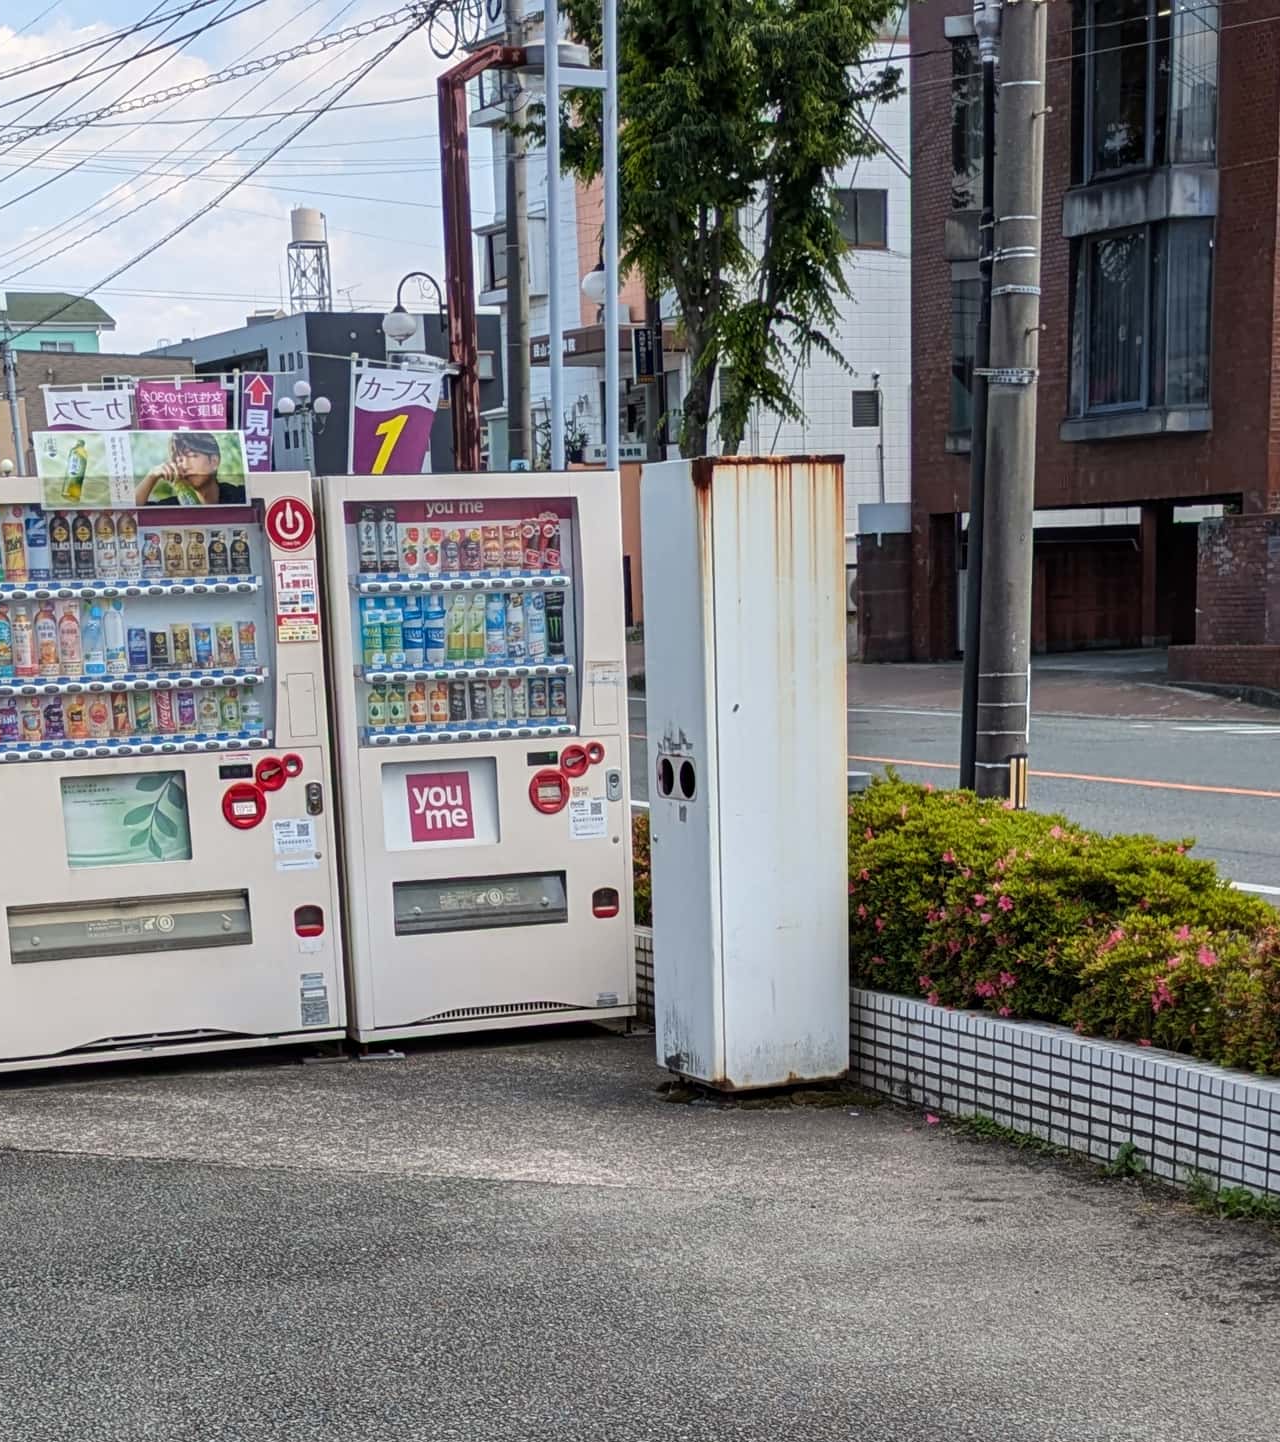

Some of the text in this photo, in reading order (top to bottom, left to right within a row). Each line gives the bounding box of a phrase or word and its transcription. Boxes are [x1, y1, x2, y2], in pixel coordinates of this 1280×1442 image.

[360, 377, 432, 404] カーブス
[244, 409, 269, 466] 見学
[426, 501, 485, 517] you me
[412, 785, 463, 814] you
[426, 808, 468, 829] me
